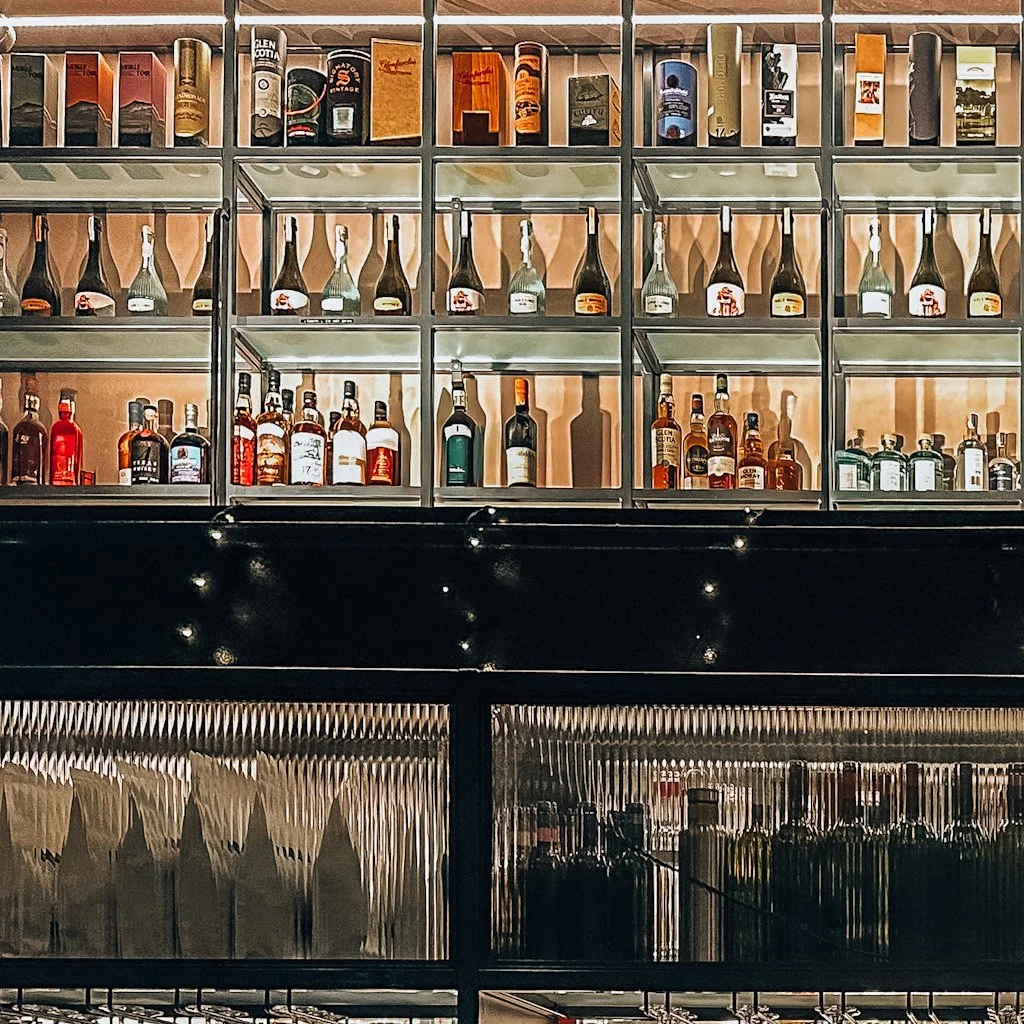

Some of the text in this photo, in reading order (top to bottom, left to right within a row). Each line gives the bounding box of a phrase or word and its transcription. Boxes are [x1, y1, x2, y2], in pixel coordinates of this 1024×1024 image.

[254, 39, 276, 50] GLEN
[329, 86, 360, 94] VINTAGE
[656, 429, 674, 437] GLEN
